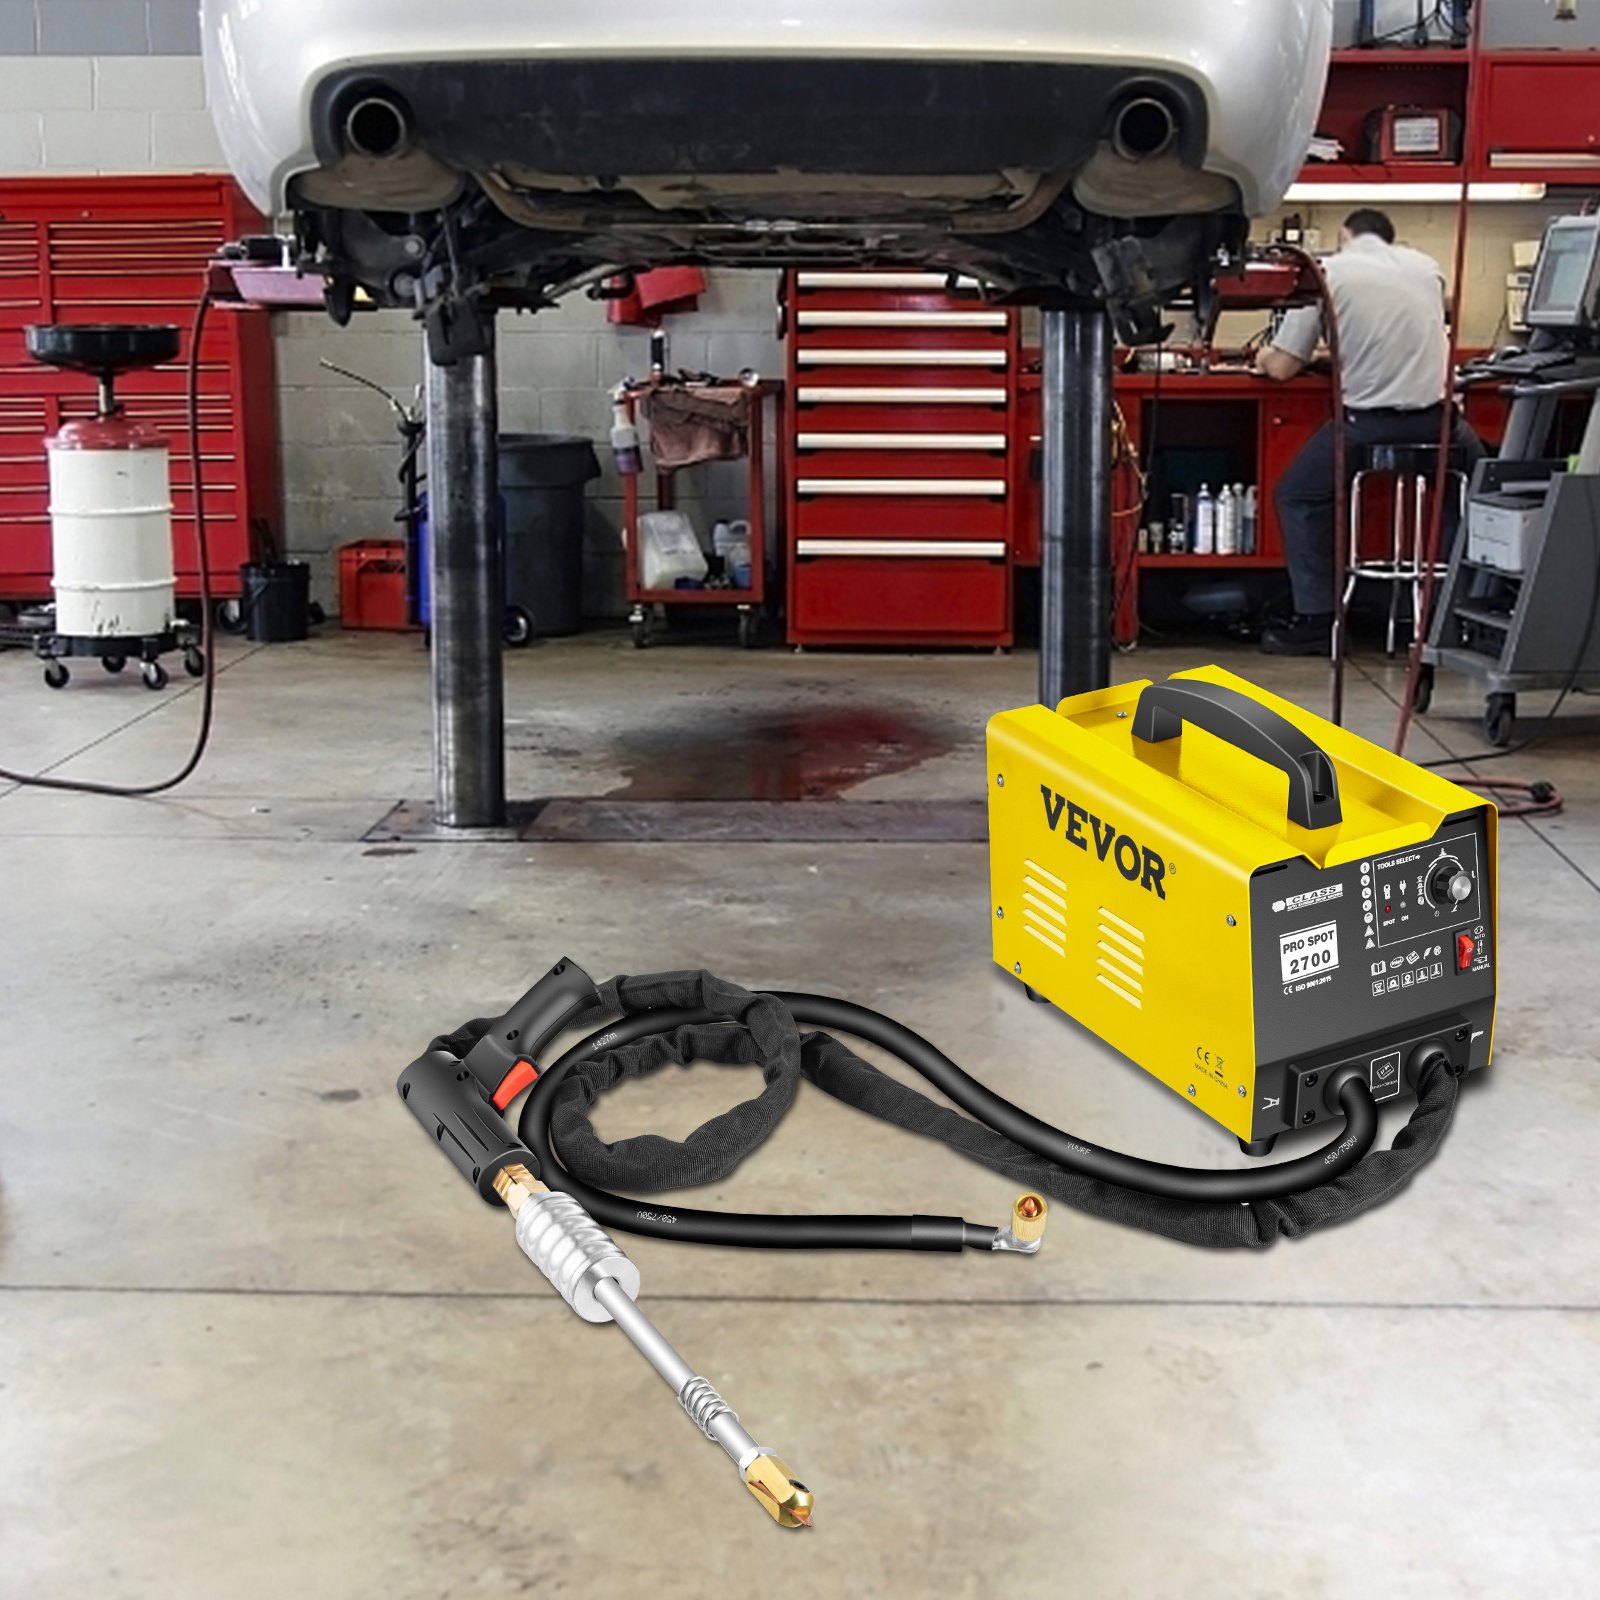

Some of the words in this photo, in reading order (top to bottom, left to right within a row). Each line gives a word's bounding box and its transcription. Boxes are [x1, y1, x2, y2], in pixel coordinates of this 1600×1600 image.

[1041, 784, 1166, 900] VEVOR
[1377, 860, 1396, 870] TOOLS
[1396, 854, 1416, 865] SELECT
[1292, 886, 1337, 903] CLASS
[1383, 918, 1396, 927] SPOT
[1283, 939, 1305, 954] PRO
[1307, 930, 1334, 946] SPOT
[1290, 949, 1331, 975] 2700
[1472, 963, 1491, 972] MANUAL
[1295, 983, 1306, 992] ISO
[1194, 1062, 1208, 1076] MADE
[1208, 1072, 1214, 1080] IN
[1213, 1076, 1229, 1089] CHINA
[1324, 1135, 1358, 1165] 450/750V
[636, 1211, 678, 1224] 450/750V
